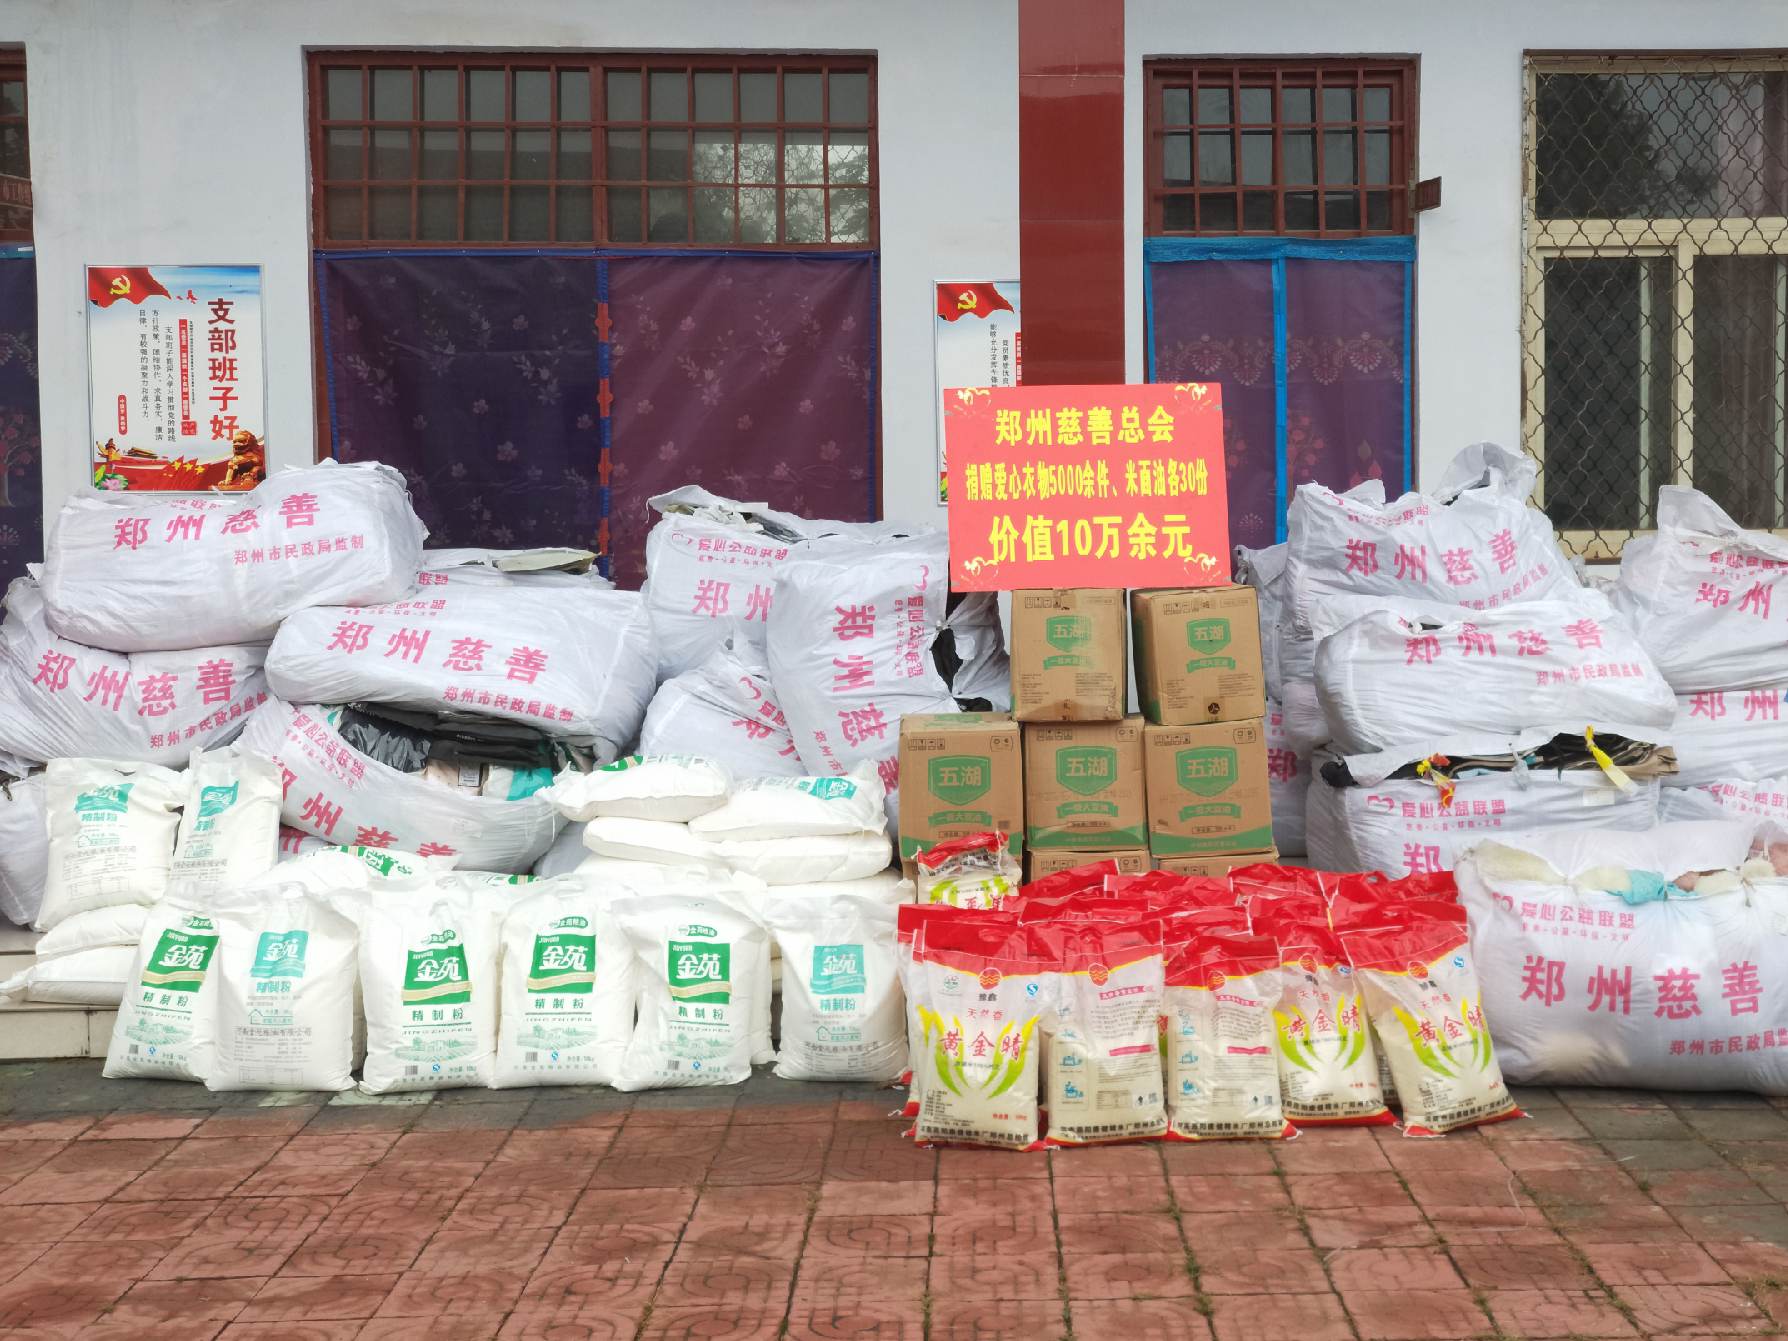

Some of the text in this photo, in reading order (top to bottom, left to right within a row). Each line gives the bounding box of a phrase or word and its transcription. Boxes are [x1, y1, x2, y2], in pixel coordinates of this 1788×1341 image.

[208, 298, 240, 441] 支部班子好
[995, 405, 1175, 447] 郑州慈善总会
[965, 458, 1209, 501] 捐赠爱心衣物5000余件、米面油各30份
[112, 492, 321, 551] 郑州慈善
[988, 512, 1193, 562] 价值10万余元
[1344, 527, 1519, 587] 郑州慈善
[326, 619, 550, 685] 郑州慈善
[1194, 624, 1225, 641] 五湖
[1404, 617, 1604, 666] 郑州慈善
[32, 648, 238, 723] 郑州慈善
[938, 766, 982, 787] 五湖
[1065, 756, 1108, 777] 五湖
[1184, 757, 1229, 778] 五湖
[538, 945, 589, 971] 金苑
[676, 953, 723, 980] 金苑
[1519, 954, 1764, 1021] 郑州慈善
[412, 1007, 465, 1022] 精制粉
[677, 1006, 724, 1020] 精制粉
